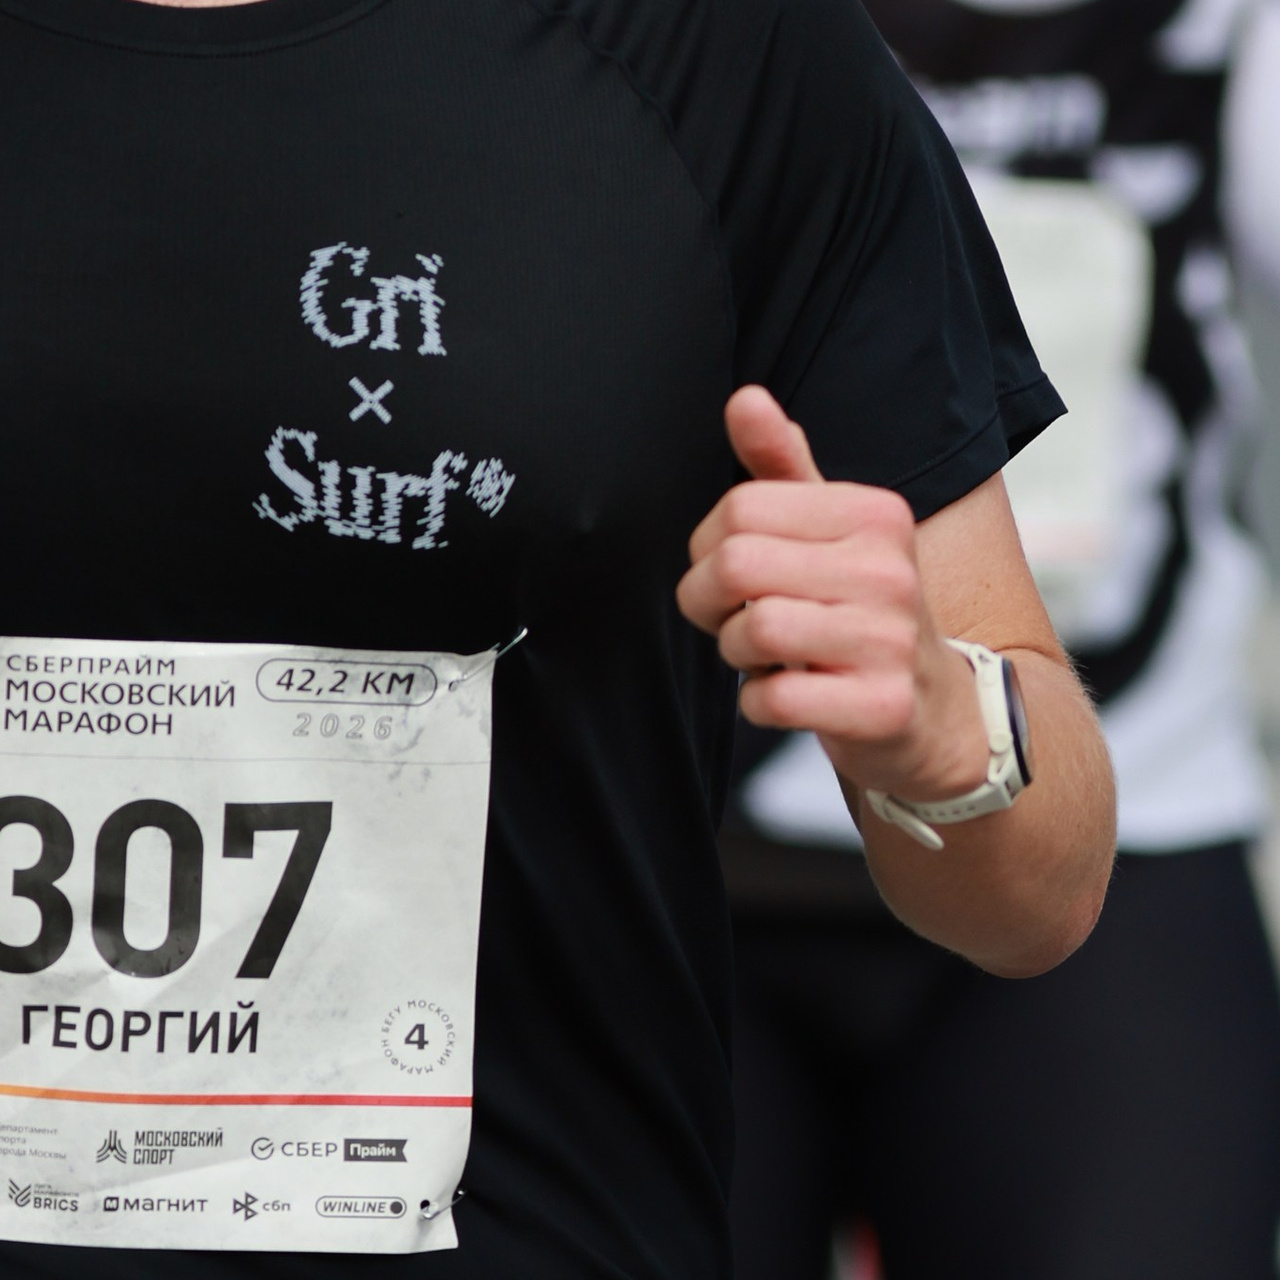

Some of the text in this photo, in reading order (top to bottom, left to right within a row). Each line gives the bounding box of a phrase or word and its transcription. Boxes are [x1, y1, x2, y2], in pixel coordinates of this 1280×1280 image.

[299, 241, 447, 356] Gri
[253, 426, 468, 549] Surf
[6, 653, 176, 676] СБЕРПРАЙМ
[5, 678, 236, 708] МОСКОВСКИЙ
[276, 668, 415, 696] 42,2 КМ
[4, 708, 173, 736] МАРАФОН
[292, 711, 393, 740] 2026
[21, 1000, 260, 1054] ГЕОРГИЙ
[381, 1005, 401, 1033] БЕГУ
[404, 1023, 429, 1050] 4
[381, 1039, 434, 1075] МАРАФОН
[134, 1127, 223, 1147] МОСКОВСКИЙ
[281, 1141, 397, 1158] СБЕР Прайм
[133, 1148, 176, 1165] СПОРТ
[33, 1197, 79, 1212] BRICS
[323, 1201, 387, 1214] WINLINE
